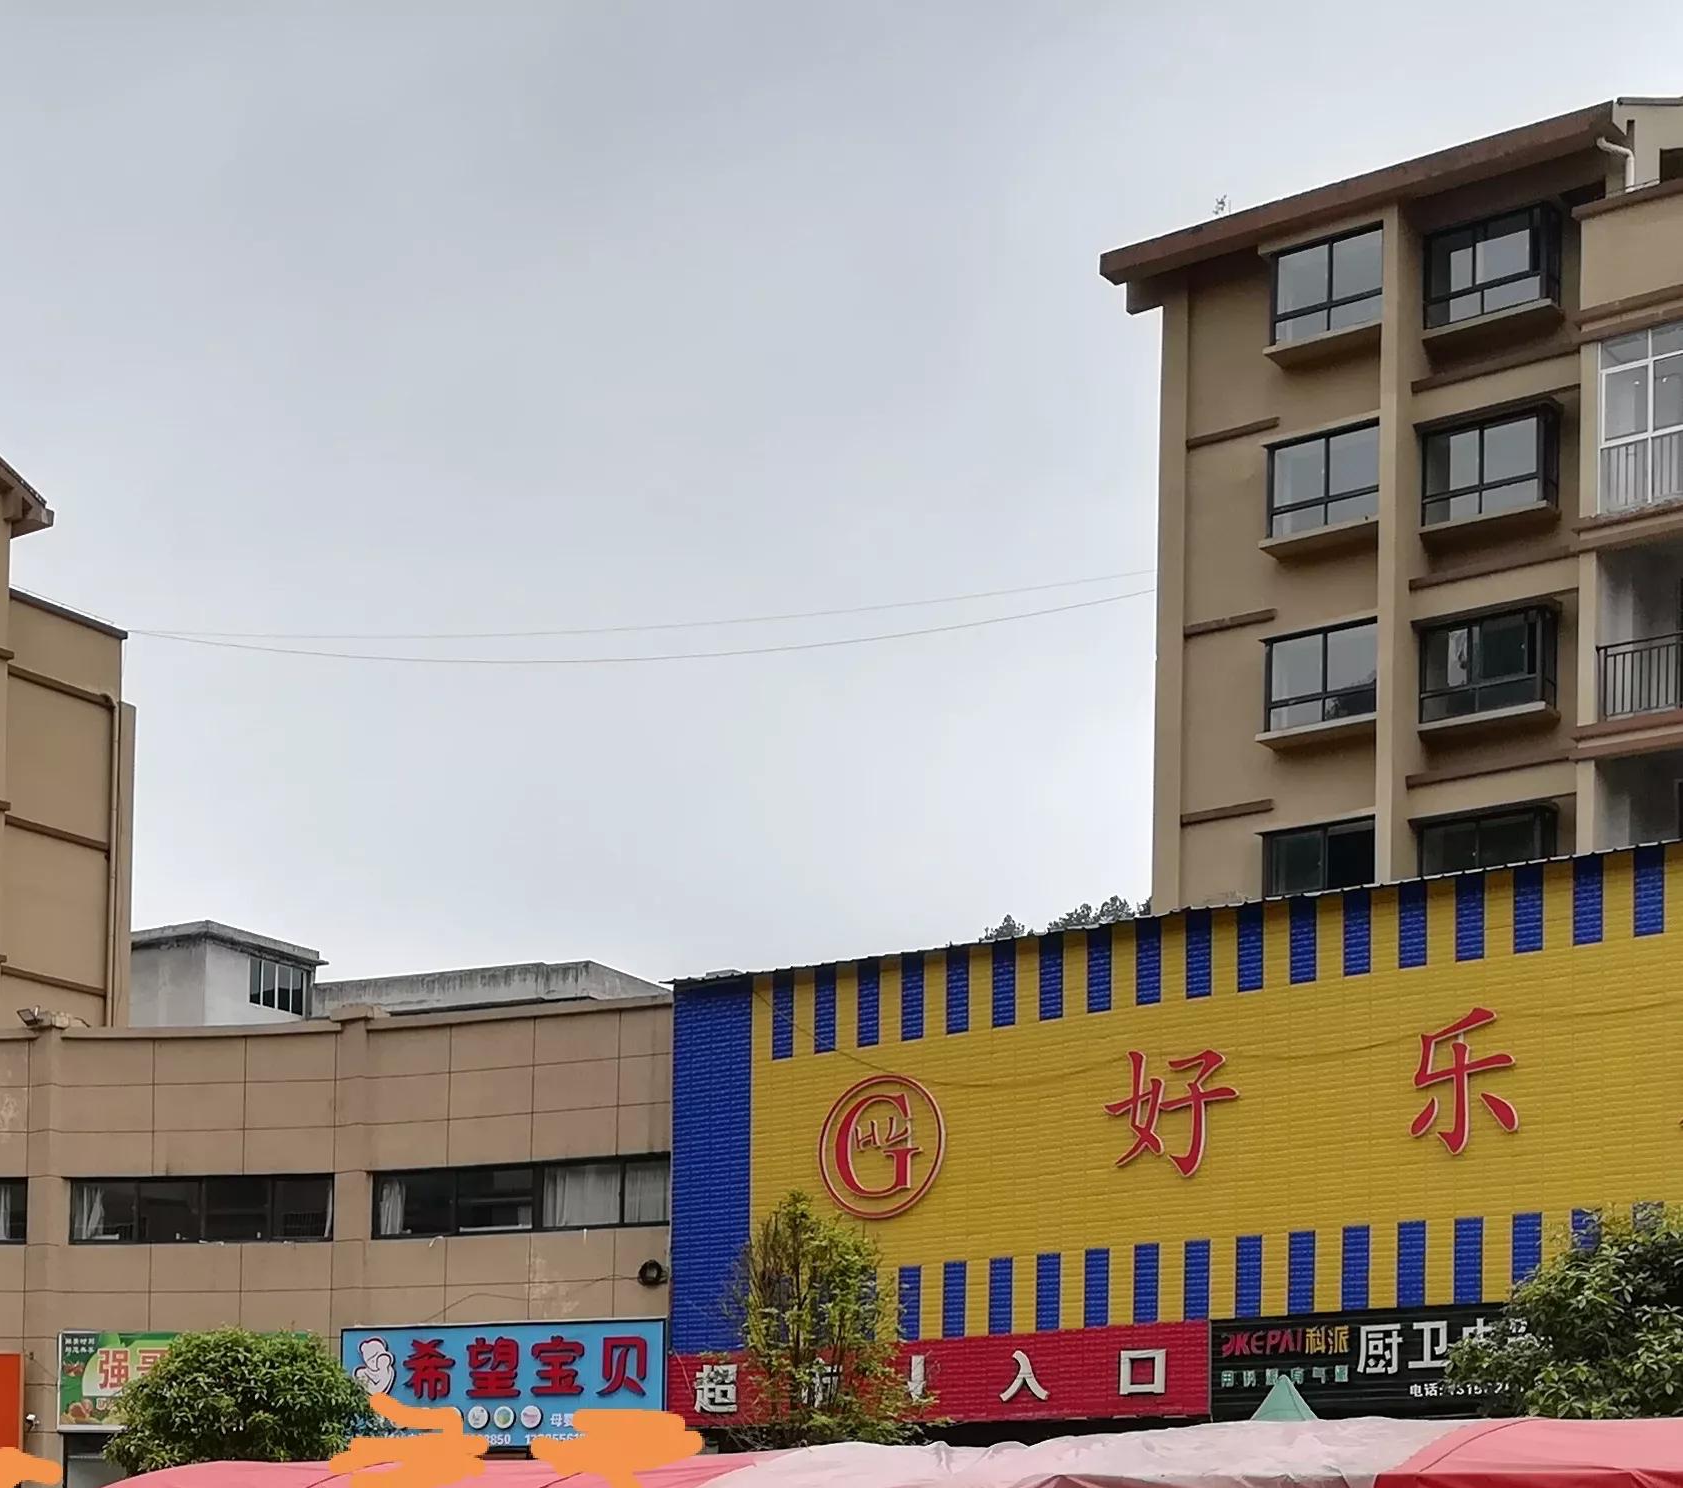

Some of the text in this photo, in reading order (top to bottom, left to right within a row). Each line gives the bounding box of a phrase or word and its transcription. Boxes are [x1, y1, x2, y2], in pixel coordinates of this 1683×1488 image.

[1305, 1325, 1350, 1355] 科派
[403, 1335, 648, 1400] 希望宝贝
